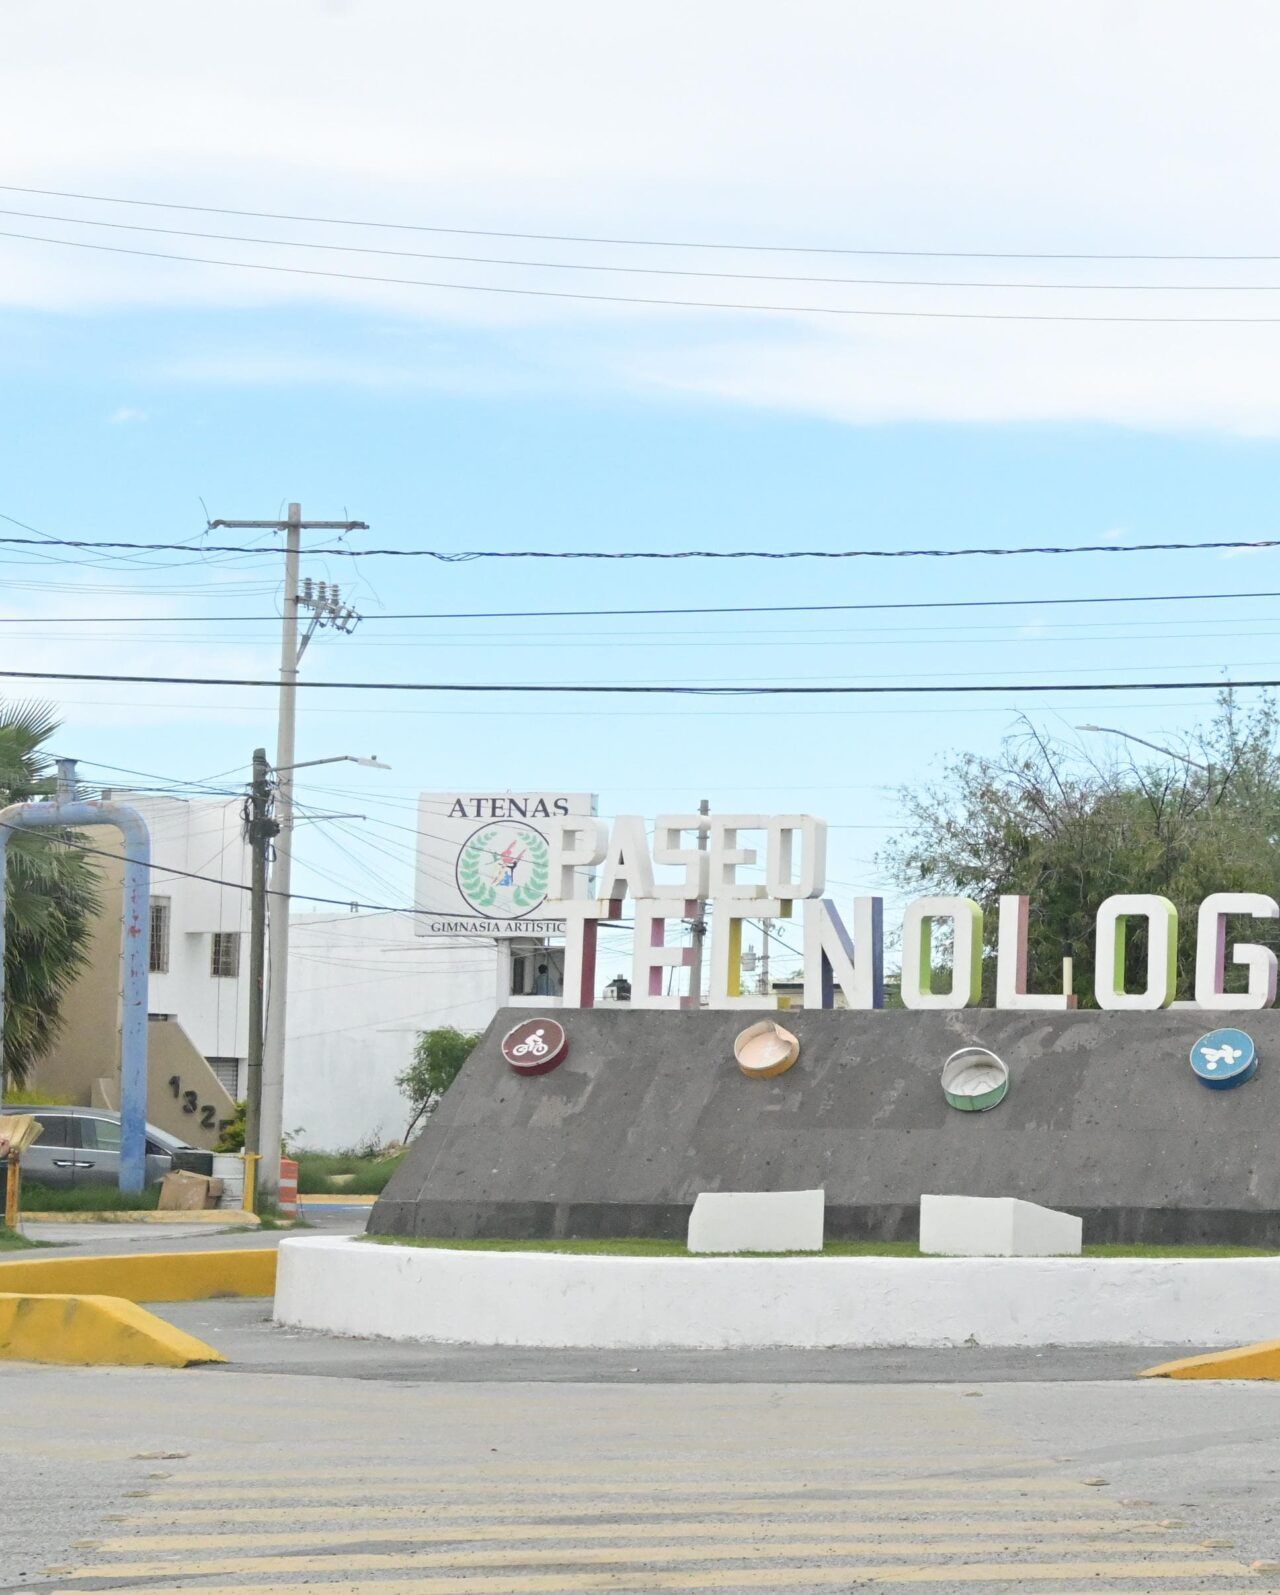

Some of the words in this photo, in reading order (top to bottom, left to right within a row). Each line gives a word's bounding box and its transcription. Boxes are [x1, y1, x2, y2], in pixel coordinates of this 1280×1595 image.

[447, 797, 569, 818] ATENAS
[545, 814, 827, 900] PASEO
[431, 921, 501, 932] GIMNASIA
[504, 920, 567, 932] ARTÍSTIC
